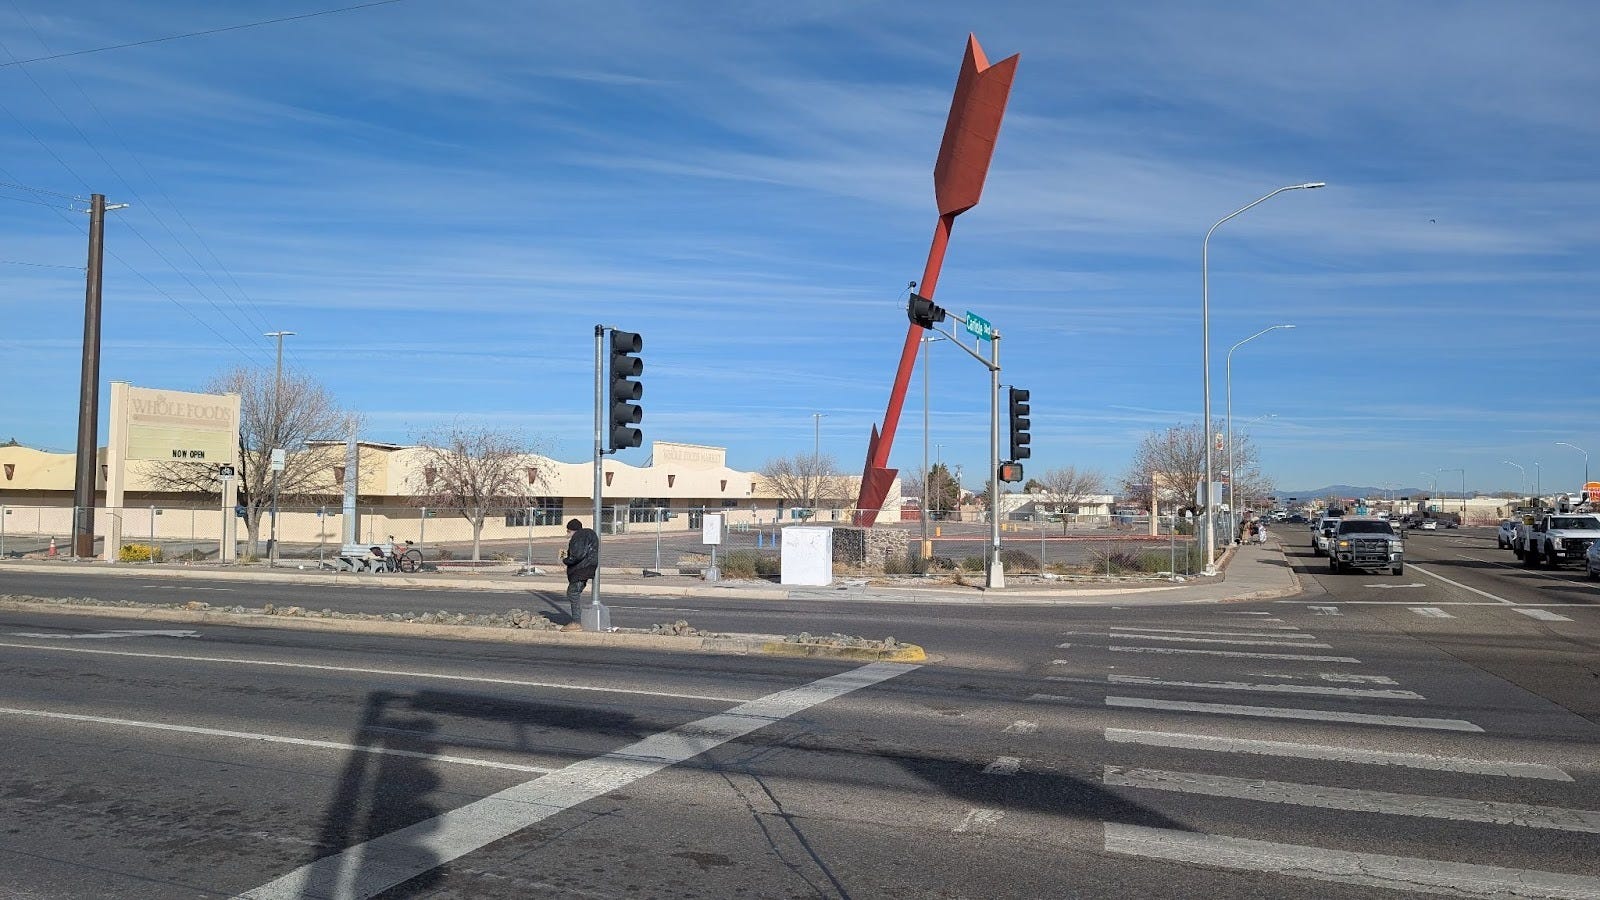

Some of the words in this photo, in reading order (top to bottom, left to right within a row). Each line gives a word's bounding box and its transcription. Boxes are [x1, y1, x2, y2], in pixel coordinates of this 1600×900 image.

[132, 398, 185, 416] WHOLE
[187, 403, 231, 420] FOODS
[172, 449, 187, 458] NOW
[189, 450, 205, 459] OPEN
